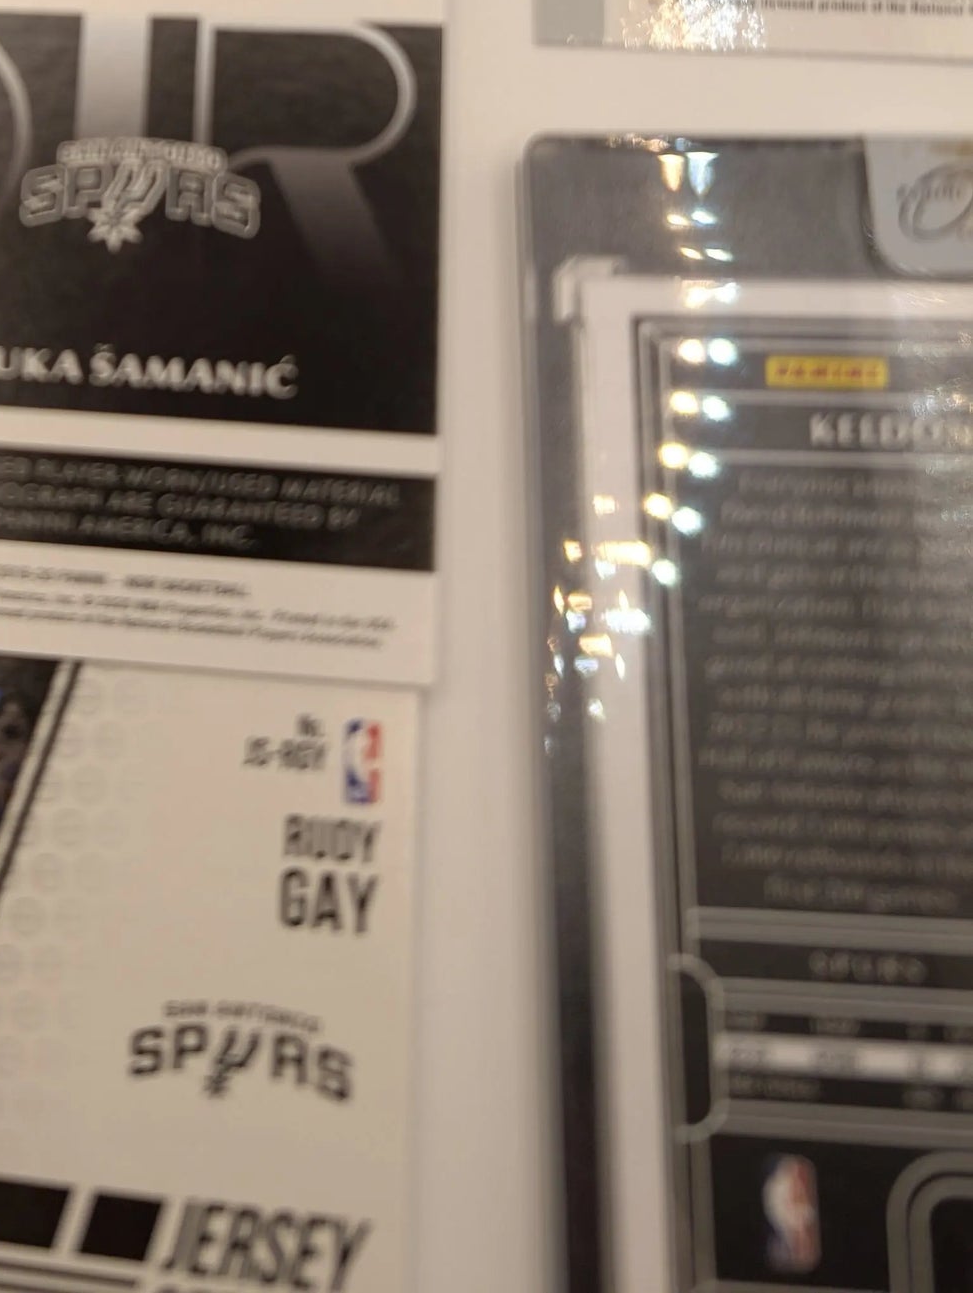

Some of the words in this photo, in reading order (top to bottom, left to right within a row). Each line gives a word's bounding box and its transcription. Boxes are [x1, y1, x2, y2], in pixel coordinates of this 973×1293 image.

[18, 162, 261, 242] SPURS
[282, 813, 383, 866] RUDY
[277, 868, 381, 937] GAY
[129, 1022, 356, 1106] SPURS
